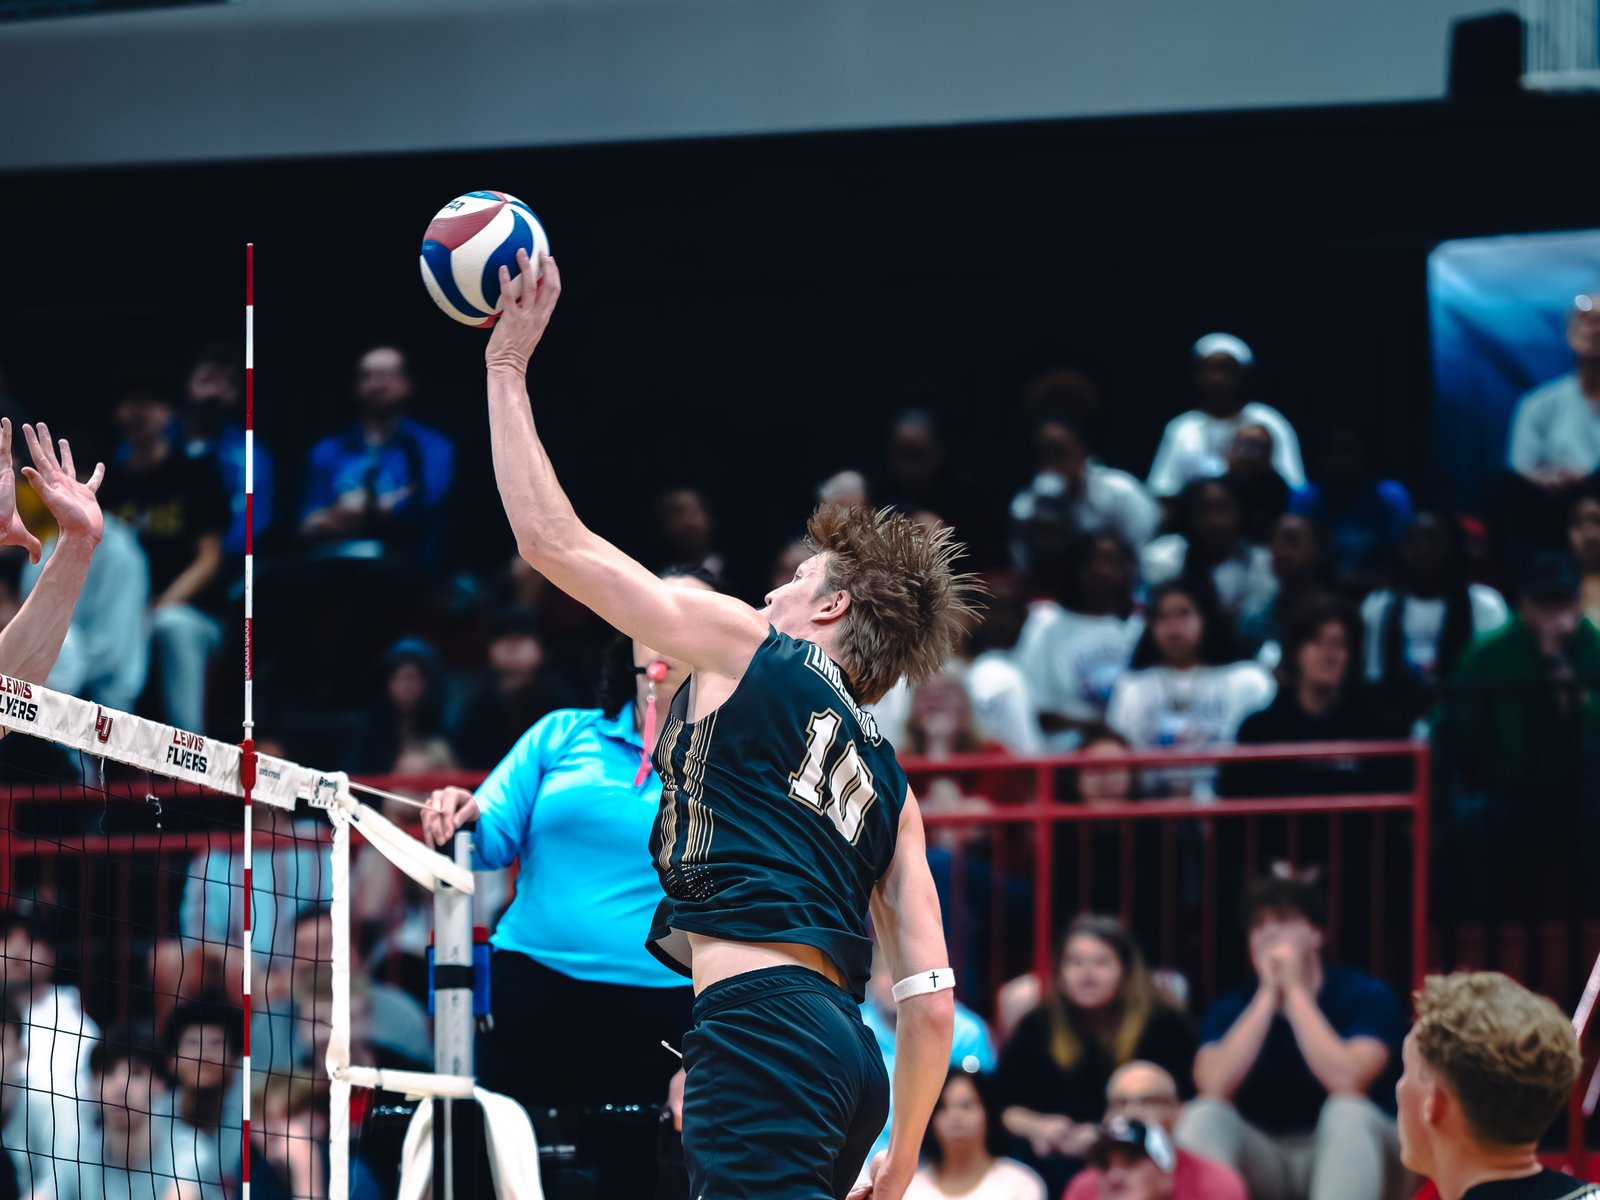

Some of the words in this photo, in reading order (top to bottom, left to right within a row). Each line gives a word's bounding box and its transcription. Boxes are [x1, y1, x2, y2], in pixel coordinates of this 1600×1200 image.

[0, 674, 32, 700] LEWIS
[95, 705, 113, 743] LU
[172, 729, 204, 752] LEWIS
[166, 745, 208, 774] FLYERS
[788, 708, 877, 846] 10
